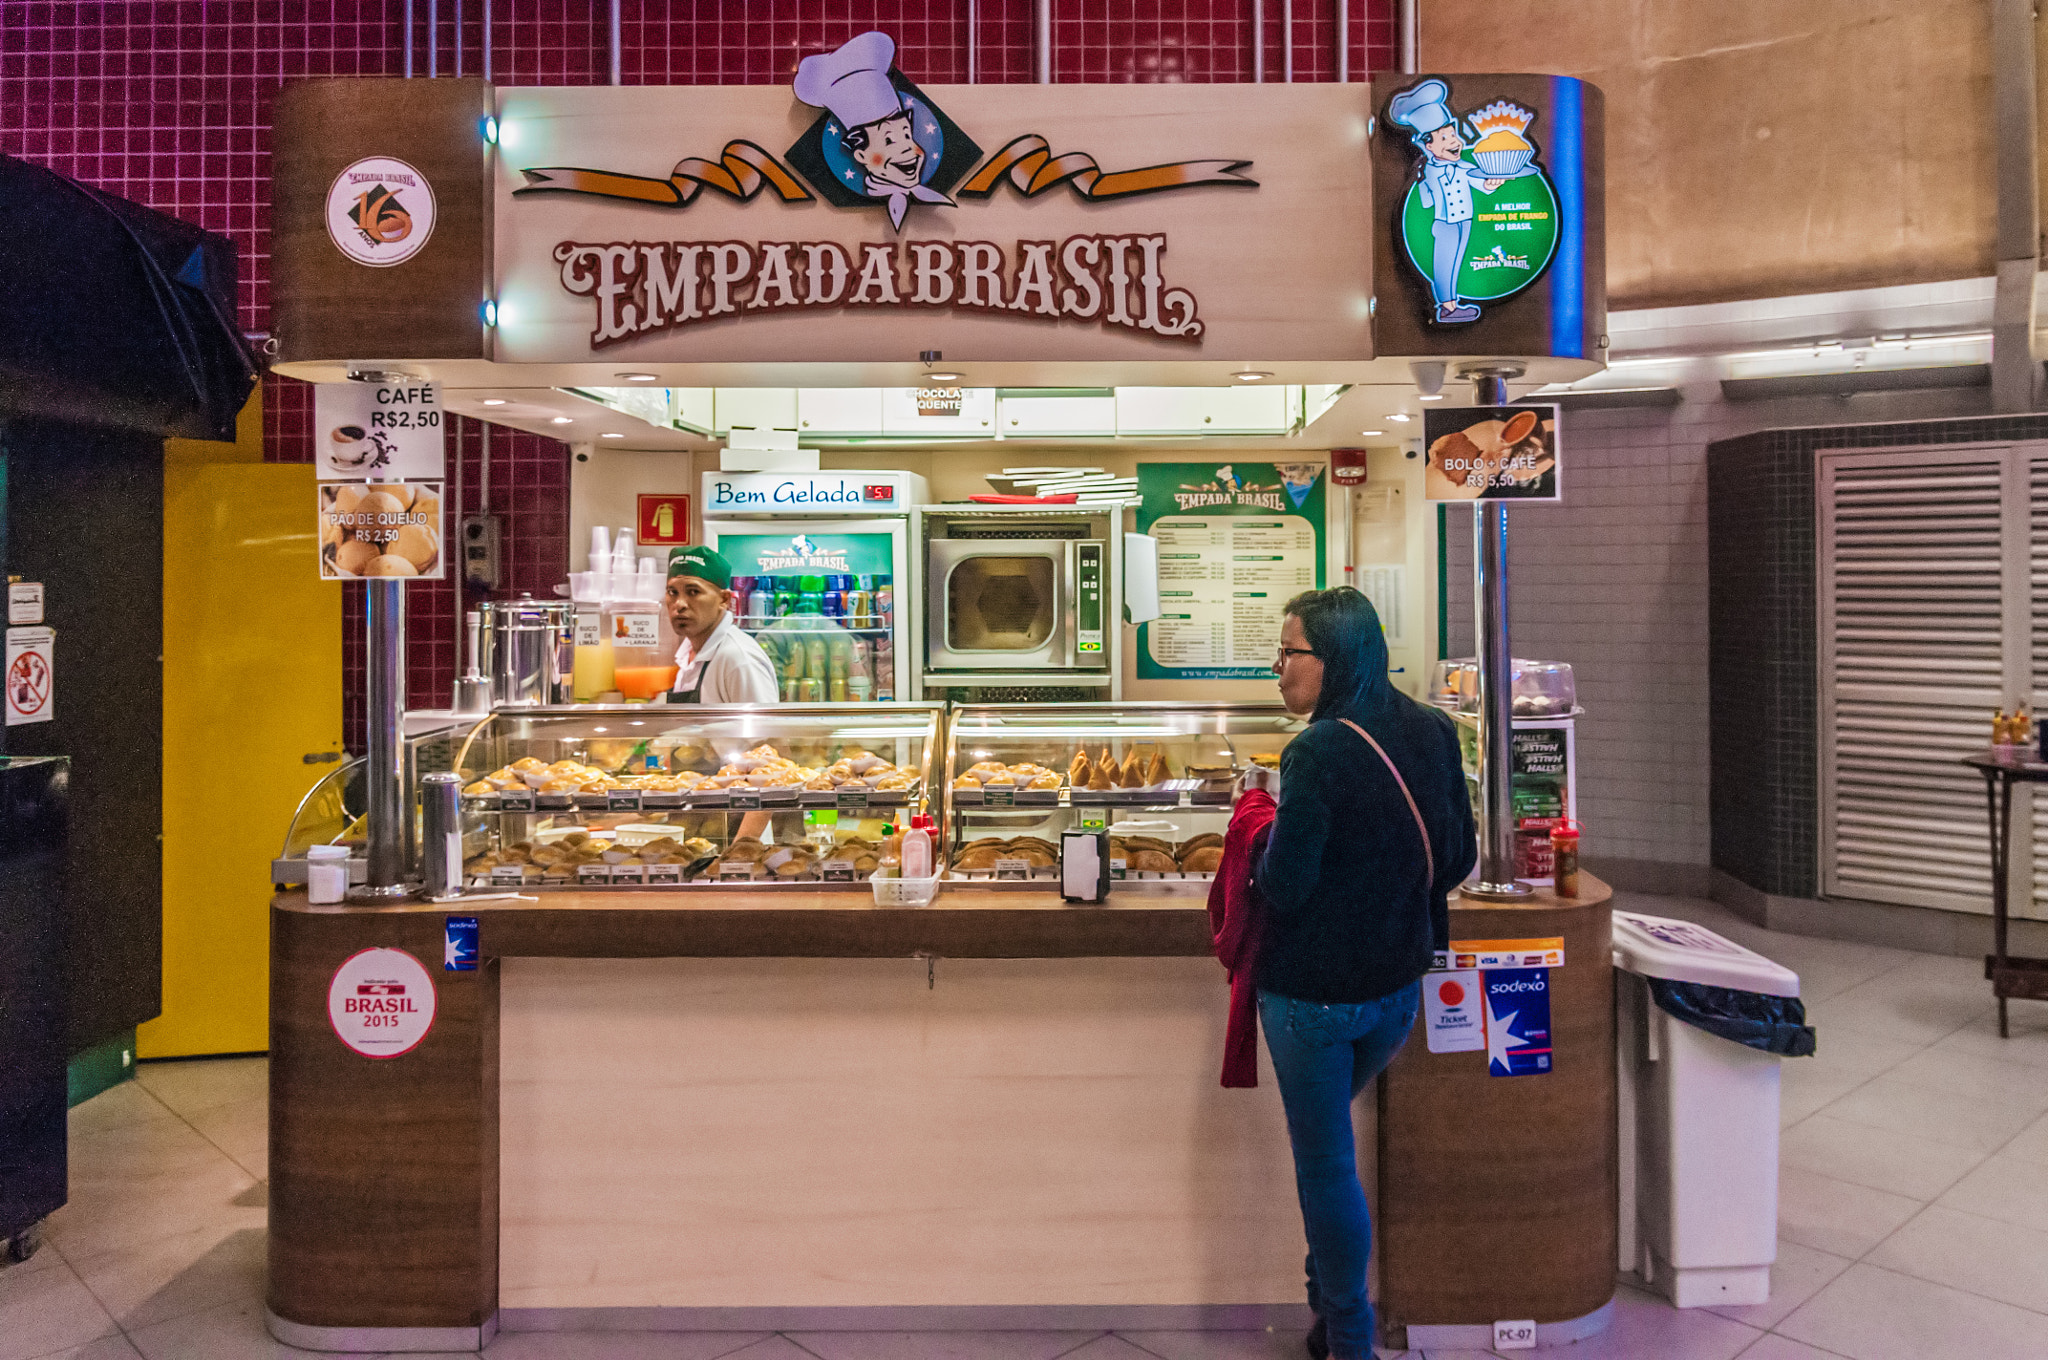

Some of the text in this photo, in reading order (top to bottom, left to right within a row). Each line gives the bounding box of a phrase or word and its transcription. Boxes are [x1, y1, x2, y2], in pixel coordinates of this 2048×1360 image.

[1502, 202, 1531, 210] MELHOR
[353, 188, 413, 243] 16
[1478, 214, 1507, 222] EMPADA
[1520, 212, 1549, 220] FRANGO
[1506, 222, 1532, 230] BRASIL
[358, 231, 375, 248] ANOS
[1470, 260, 1530, 271] EMPADA BRASIL
[553, 233, 1204, 348] EMPADA BRASIL
[376, 384, 434, 404] CAFÉ
[918, 400, 962, 410] QUENTE
[371, 411, 439, 430] R$2,50
[1444, 453, 1537, 471] BOLO + CAFÉ
[1466, 474, 1515, 488] R$ 5,50
[714, 480, 860, 504] Bem Gelada
[1174, 492, 1286, 511] EMPADA BRASIL
[330, 511, 428, 525] PÃO DE QUEIJO
[355, 529, 400, 544] R$ 2,50
[756, 556, 850, 572] EMPADA BRASIL
[1526, 764, 1556, 773] HALLS
[1490, 980, 1546, 994] sodexo
[345, 998, 418, 1013] BRASIL
[364, 1015, 399, 1027] 2015
[1440, 1015, 1468, 1024] Ticket
[1499, 1329, 1532, 1340] PC-07
